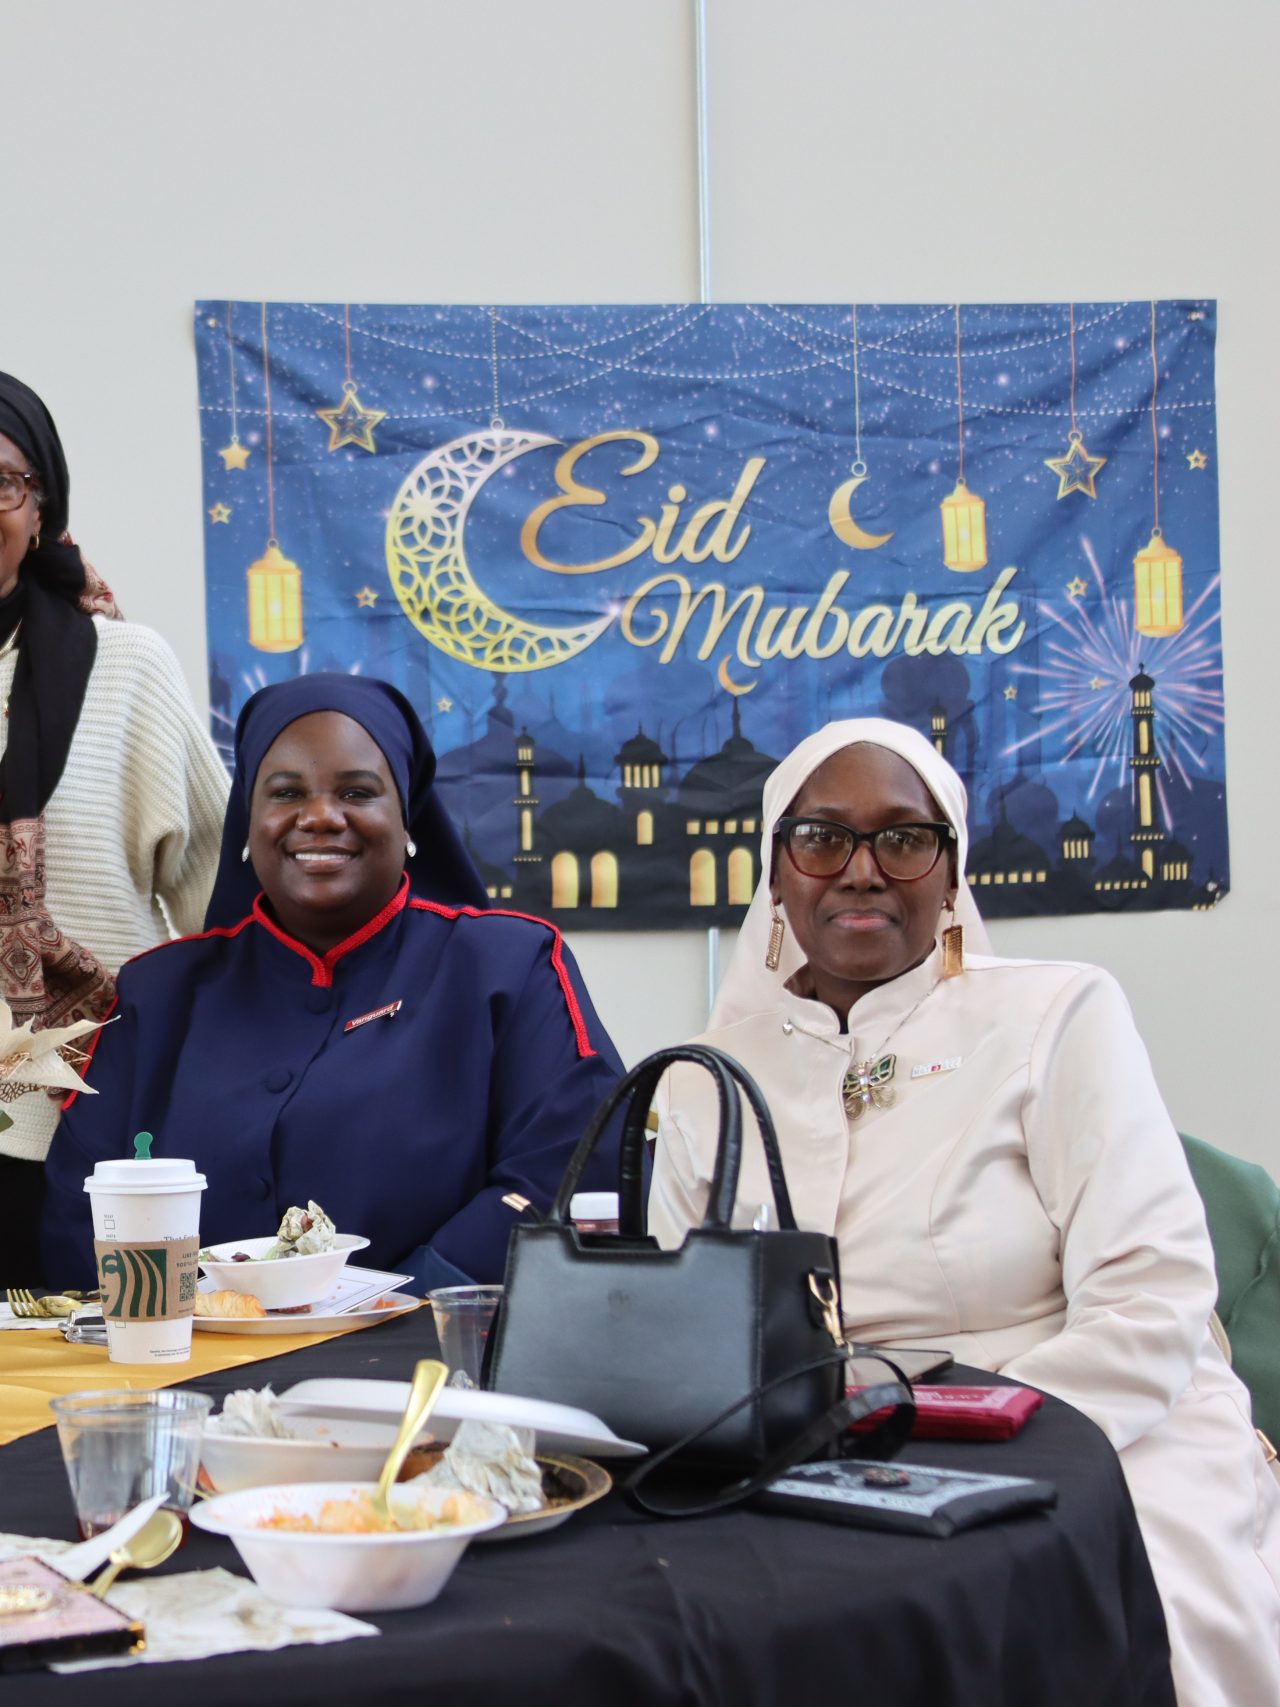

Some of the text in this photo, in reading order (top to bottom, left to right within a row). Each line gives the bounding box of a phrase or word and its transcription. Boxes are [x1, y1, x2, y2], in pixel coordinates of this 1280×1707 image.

[520, 430, 766, 575] Eid
[621, 567, 1026, 667] Mubarak
[351, 1003, 394, 1026] Vanguard
